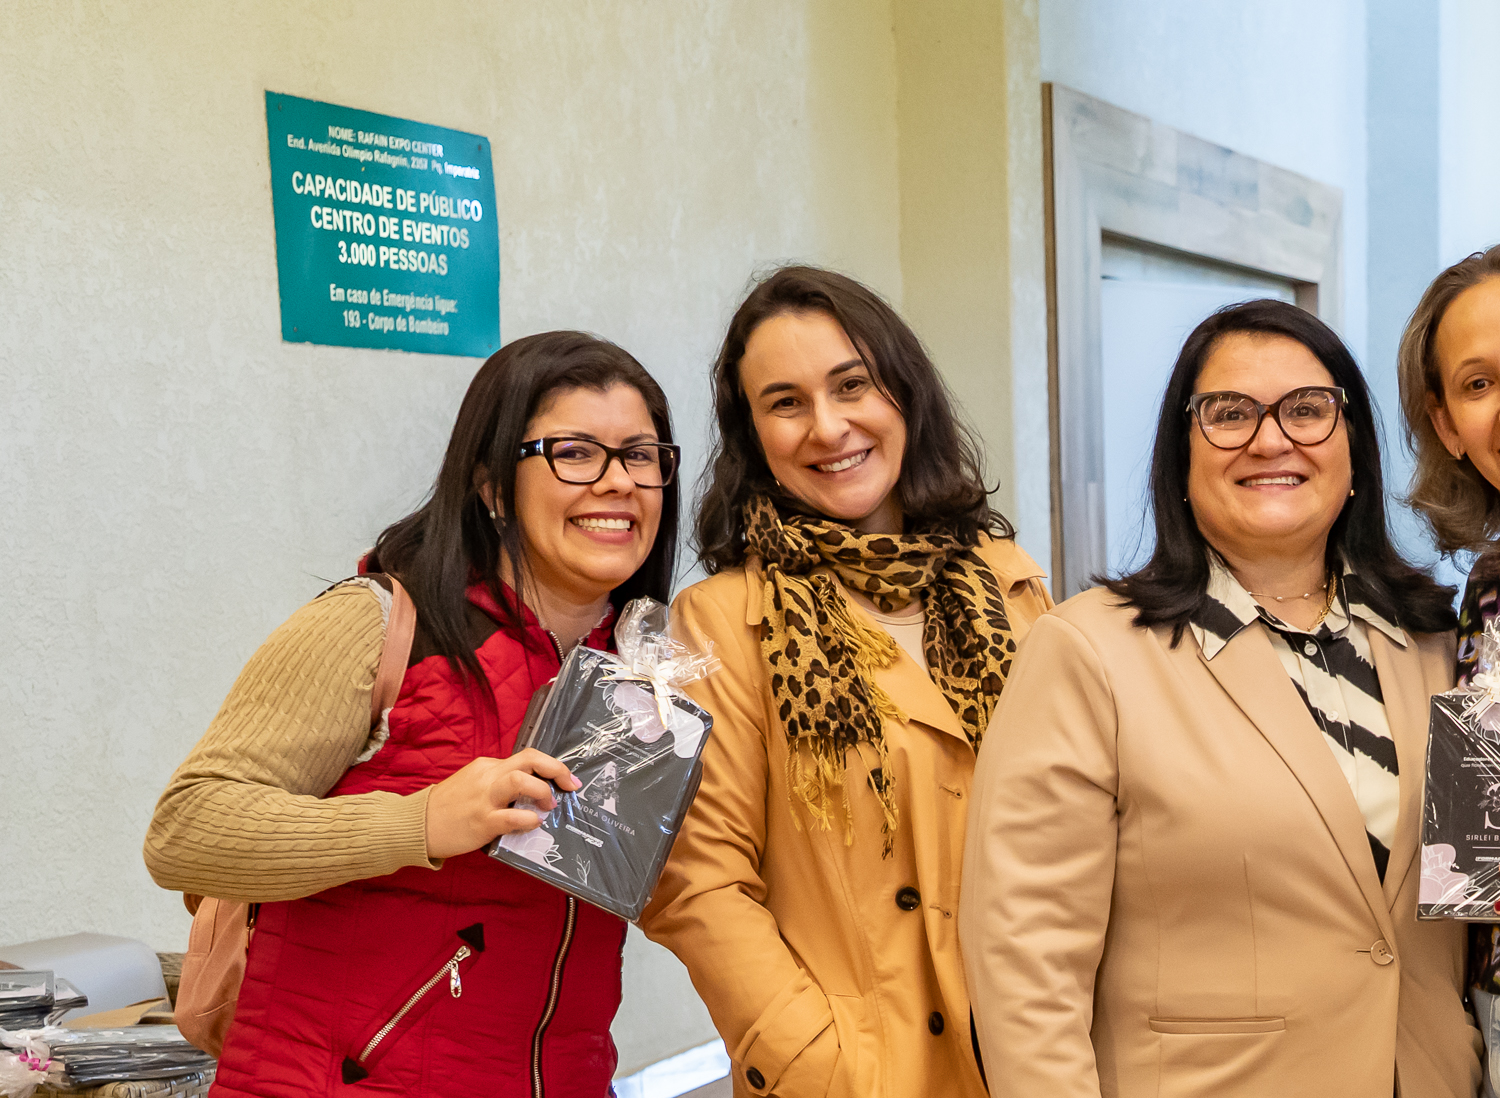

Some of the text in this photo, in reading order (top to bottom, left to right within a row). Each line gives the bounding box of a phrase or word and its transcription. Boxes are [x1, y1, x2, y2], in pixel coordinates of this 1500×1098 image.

[287, 134, 307, 150] End.
[308, 138, 341, 156] Avenida
[328, 125, 444, 158] NOME: RAFAIN EXPO CENTER
[291, 170, 483, 222] CAPACIDADE DE PÚBLICO
[311, 205, 470, 249] CENTRO DE EVENTOS
[338, 241, 448, 276] 3.000 PESSOAS
[329, 283, 345, 302] Em
[347, 288, 368, 304] caso
[370, 287, 381, 306] de
[343, 309, 361, 328] 193
[368, 312, 395, 334] Corpo
[396, 314, 408, 333] de
[601, 814, 636, 837] OLIVEIRA
[1466, 834, 1491, 842] SIRLEI
